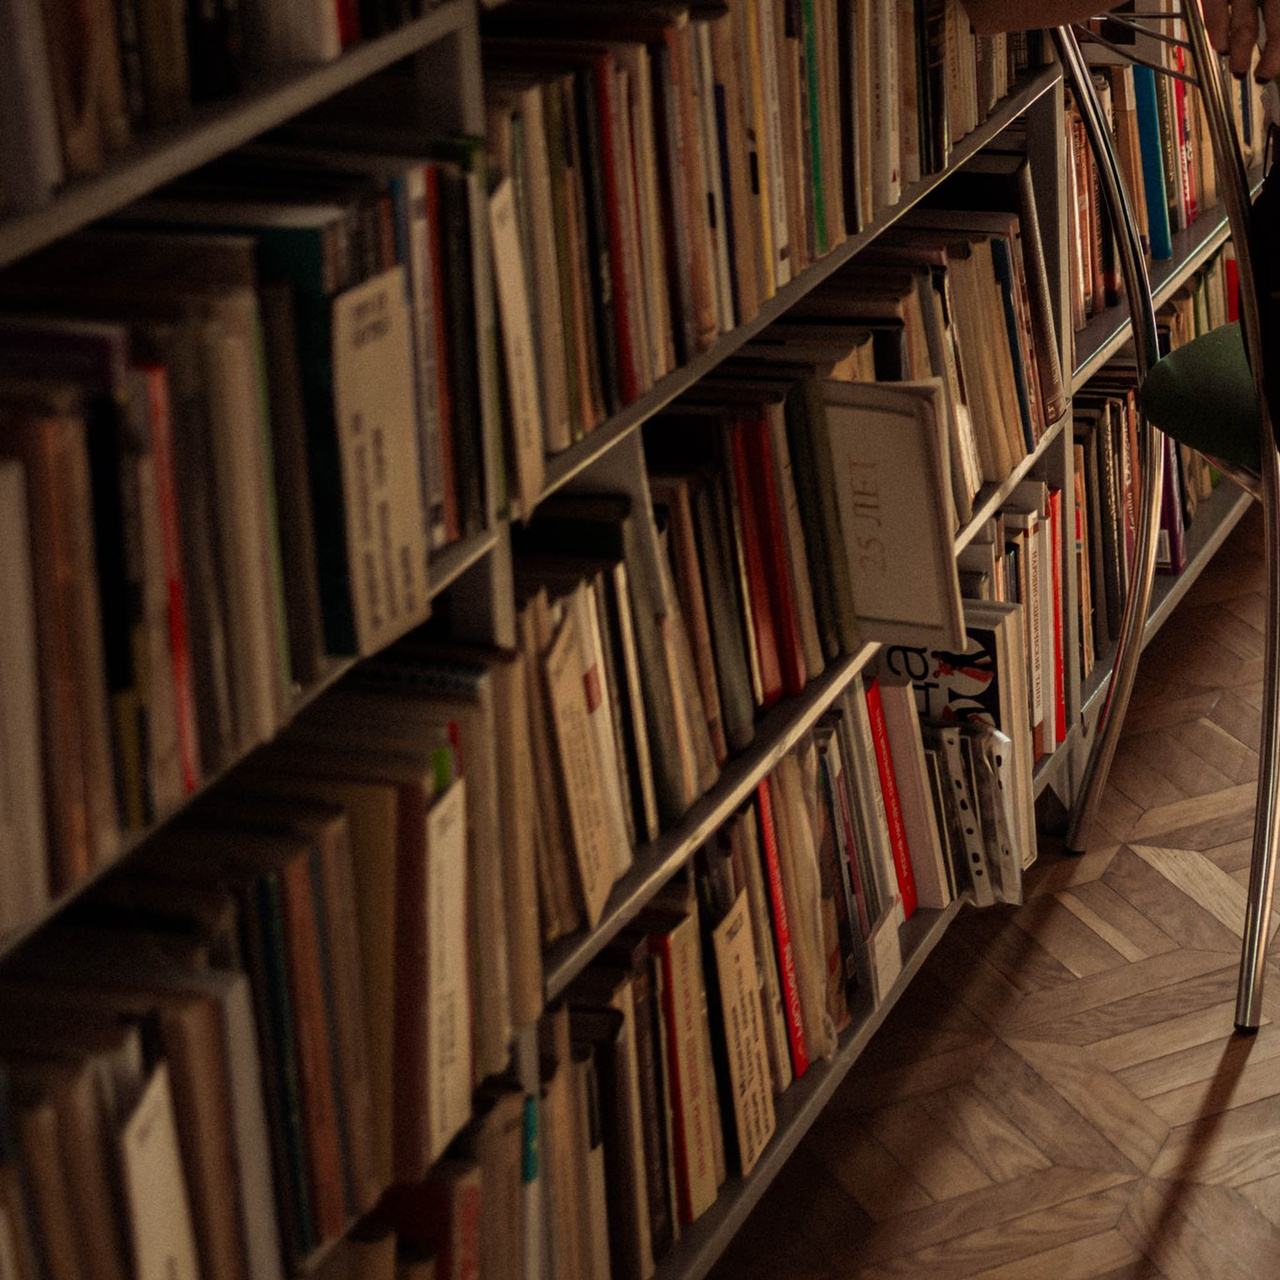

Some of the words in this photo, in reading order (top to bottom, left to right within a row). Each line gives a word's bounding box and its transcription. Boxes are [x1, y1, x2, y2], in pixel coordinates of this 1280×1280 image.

[848, 452, 881, 527] ЛЕТ
[857, 535, 887, 577] 25
[1031, 550, 1040, 672] НАРОДНО-СЦЕНИЧЕСКИЙ
[1034, 675, 1042, 709] ТАНЕЦ
